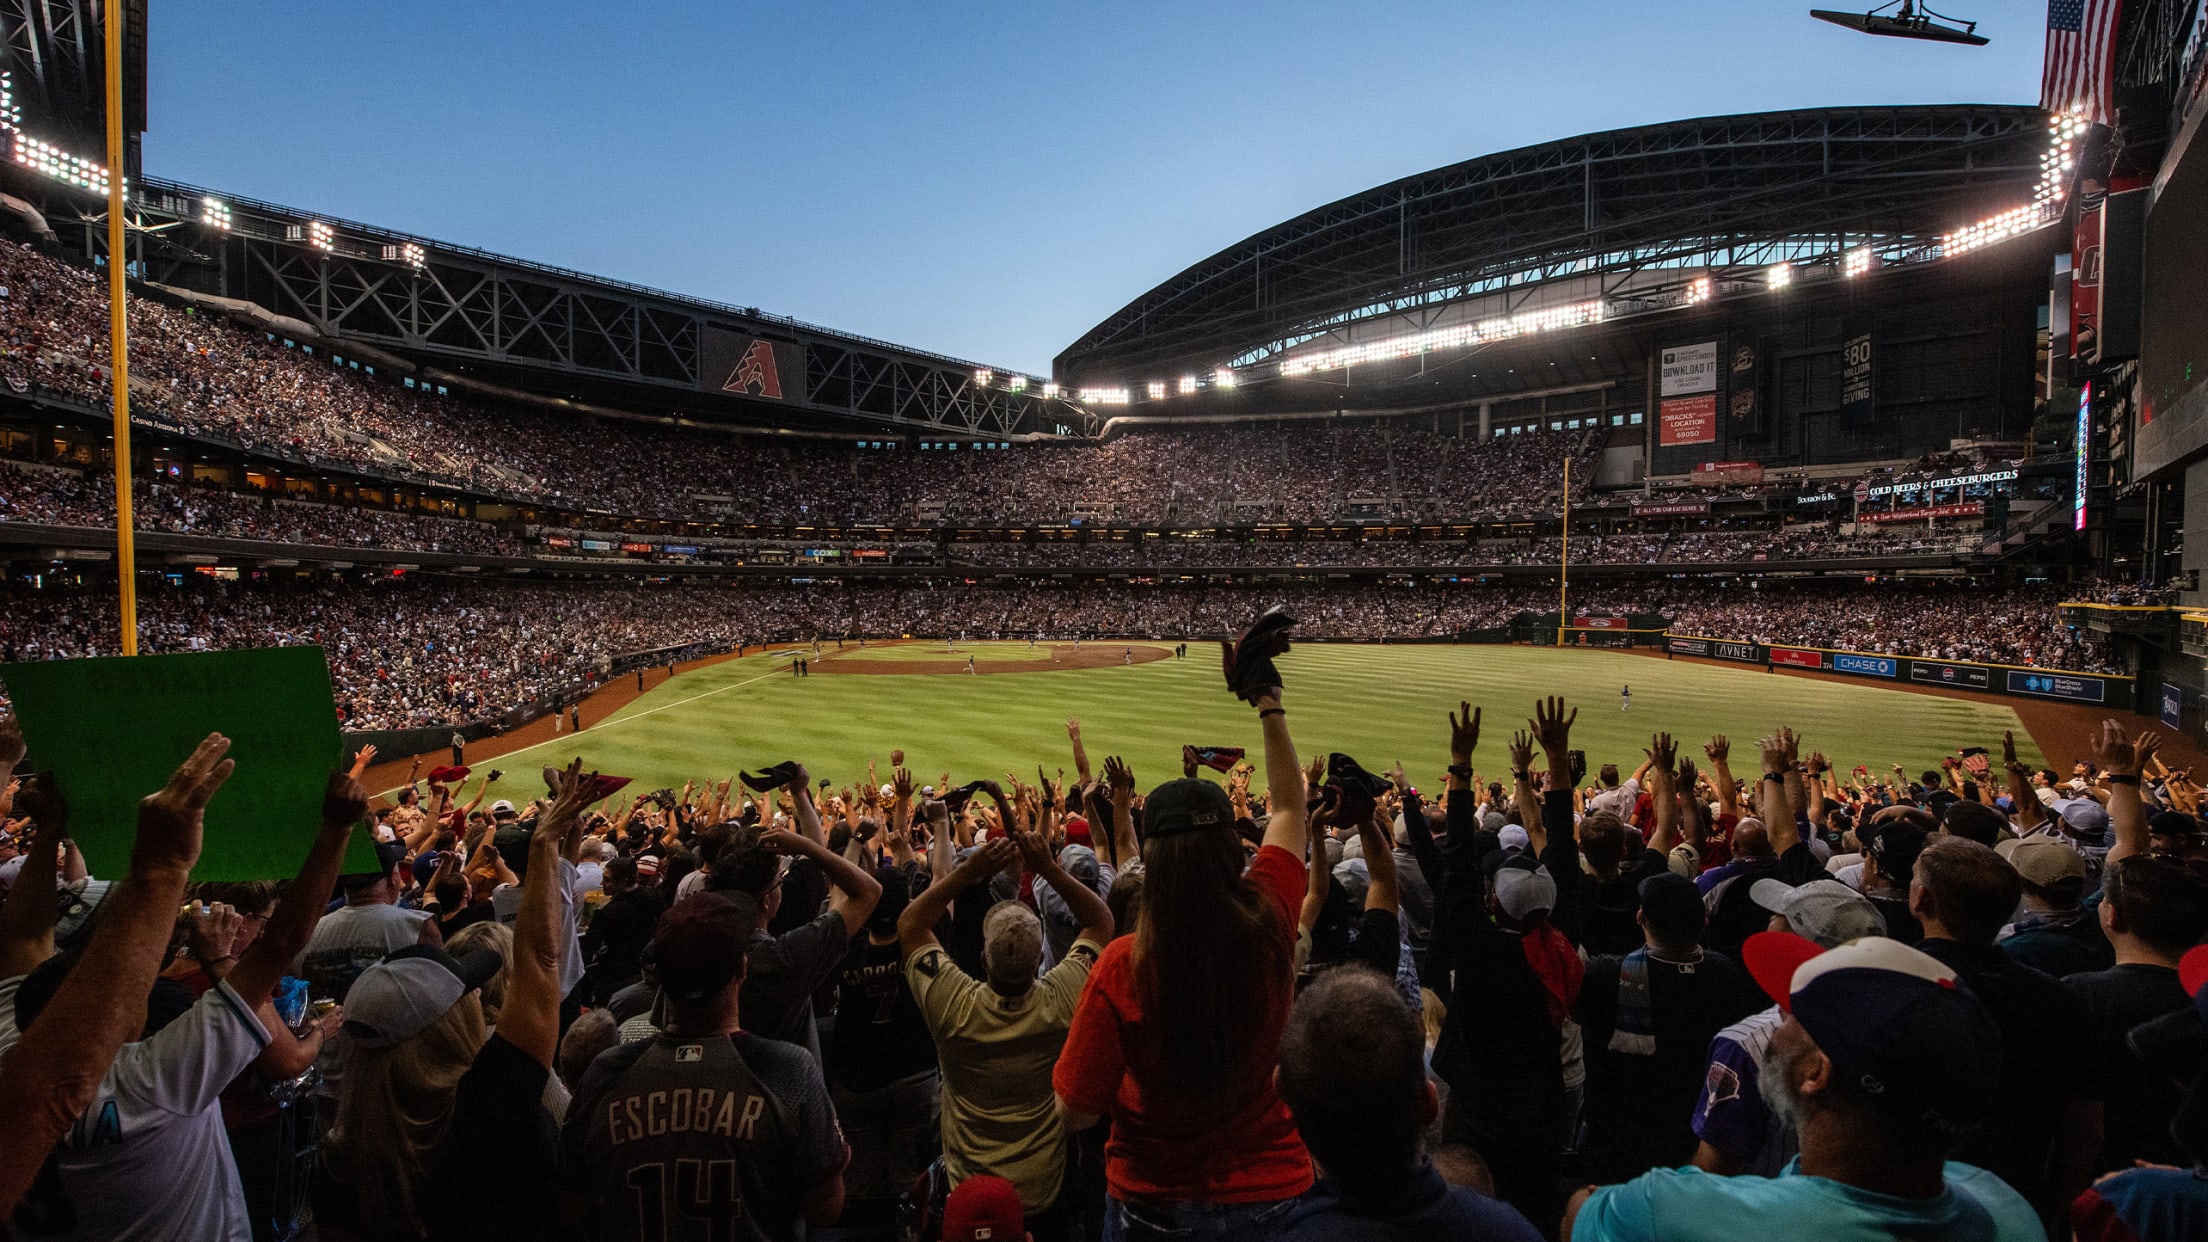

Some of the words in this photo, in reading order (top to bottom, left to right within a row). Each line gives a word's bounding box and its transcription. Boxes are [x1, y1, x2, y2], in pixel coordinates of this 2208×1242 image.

[1844, 341, 1871, 366] $80
[1663, 363, 1704, 378] DOWNLOAD
[1707, 361, 1715, 372] IT
[1843, 362, 1871, 380] MILLION
[1843, 387, 1870, 404] GIVING
[1670, 418, 1705, 428] LOCATION
[1869, 485, 1891, 496] COLD
[1892, 481, 1922, 494] BEERS
[1923, 481, 1930, 490] &
[1930, 469, 2019, 489] CHEESEBURGERS
[1720, 645, 1754, 658] AVNET
[1841, 658, 1877, 671] CHASE
[2054, 678, 2081, 686] BlueCross
[2054, 683, 2083, 691] BlueShield
[608, 1087, 765, 1145] ESCOBAR
[627, 1158, 741, 1242] 14
